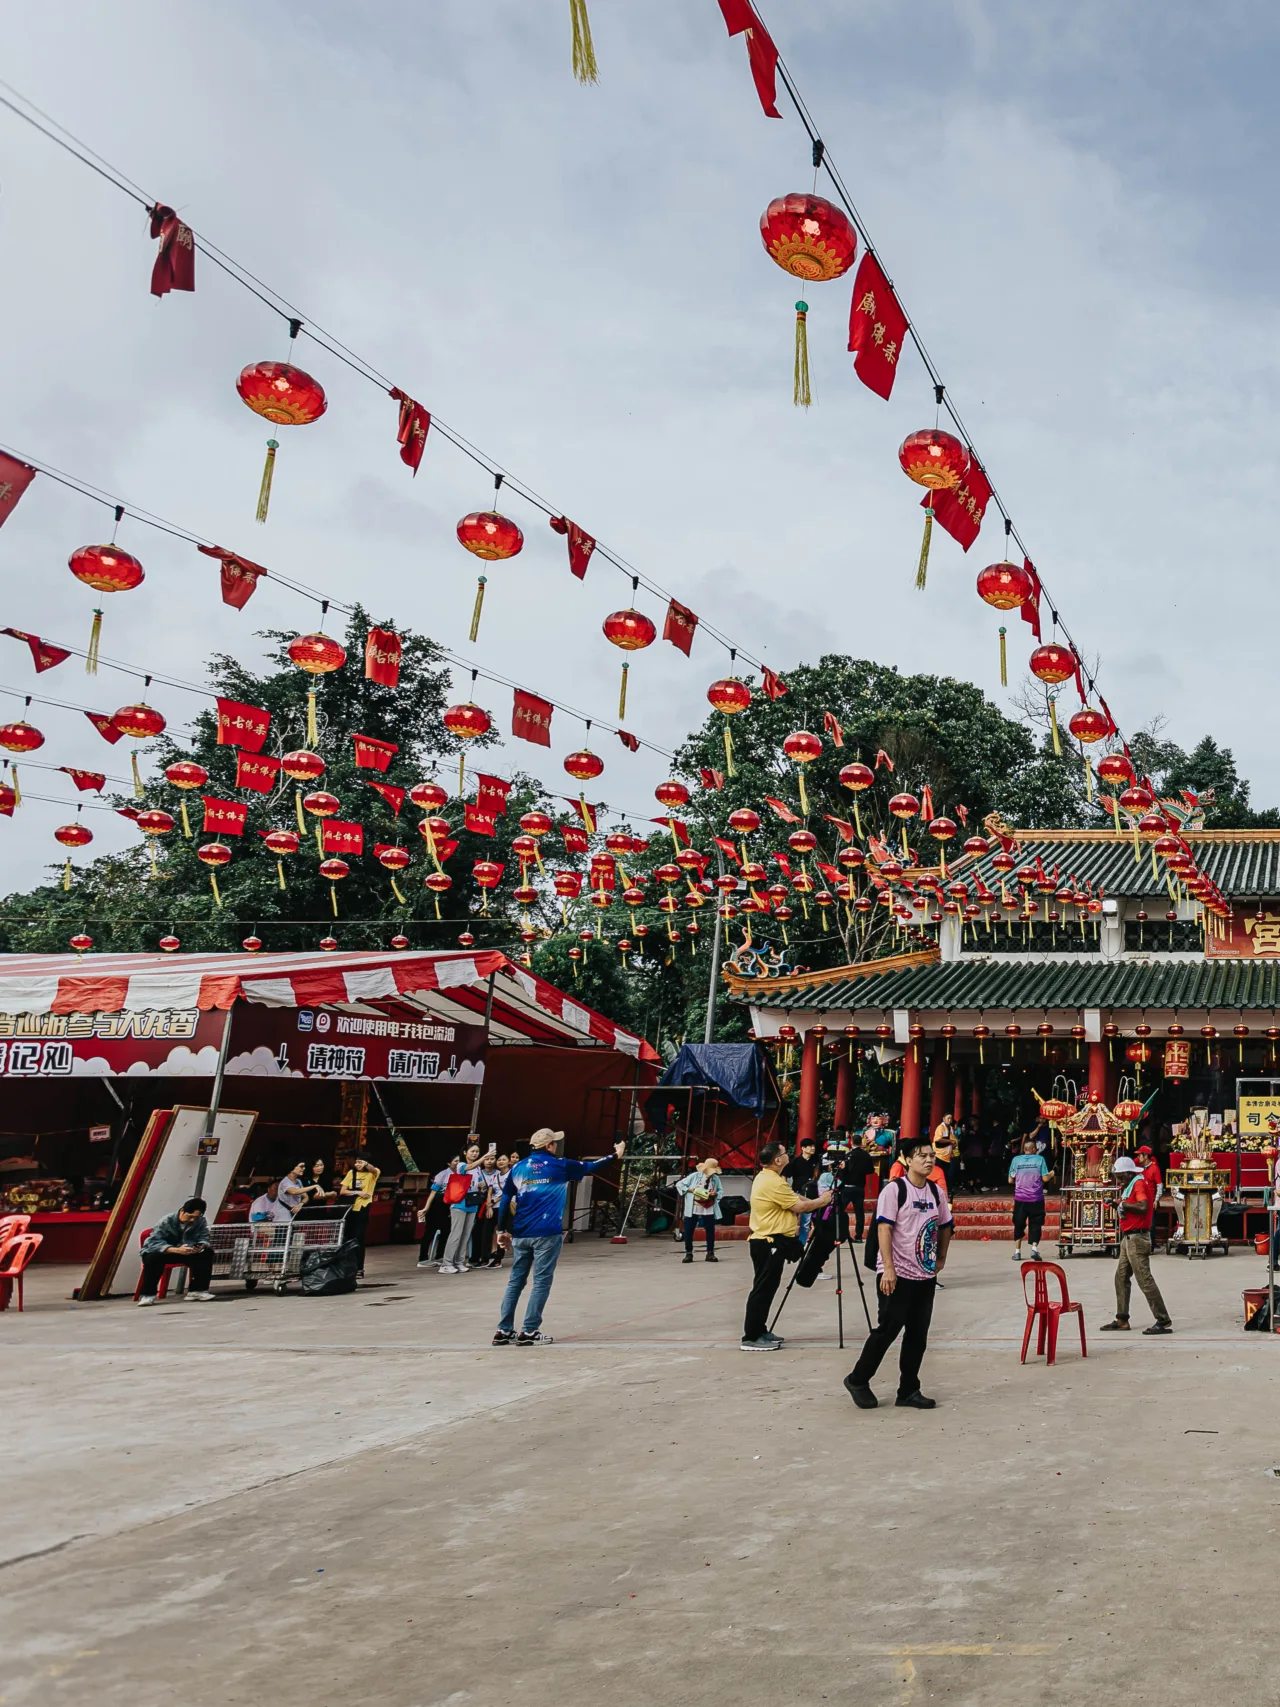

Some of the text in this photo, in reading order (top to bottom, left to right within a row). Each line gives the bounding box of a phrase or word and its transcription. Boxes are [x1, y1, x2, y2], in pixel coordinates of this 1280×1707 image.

[336, 1016, 455, 1042] 欢迎使用电子钱包添油
[0, 1046, 70, 1070] 记处
[309, 1045, 364, 1074] 请神符
[390, 1049, 439, 1077] 请门符
